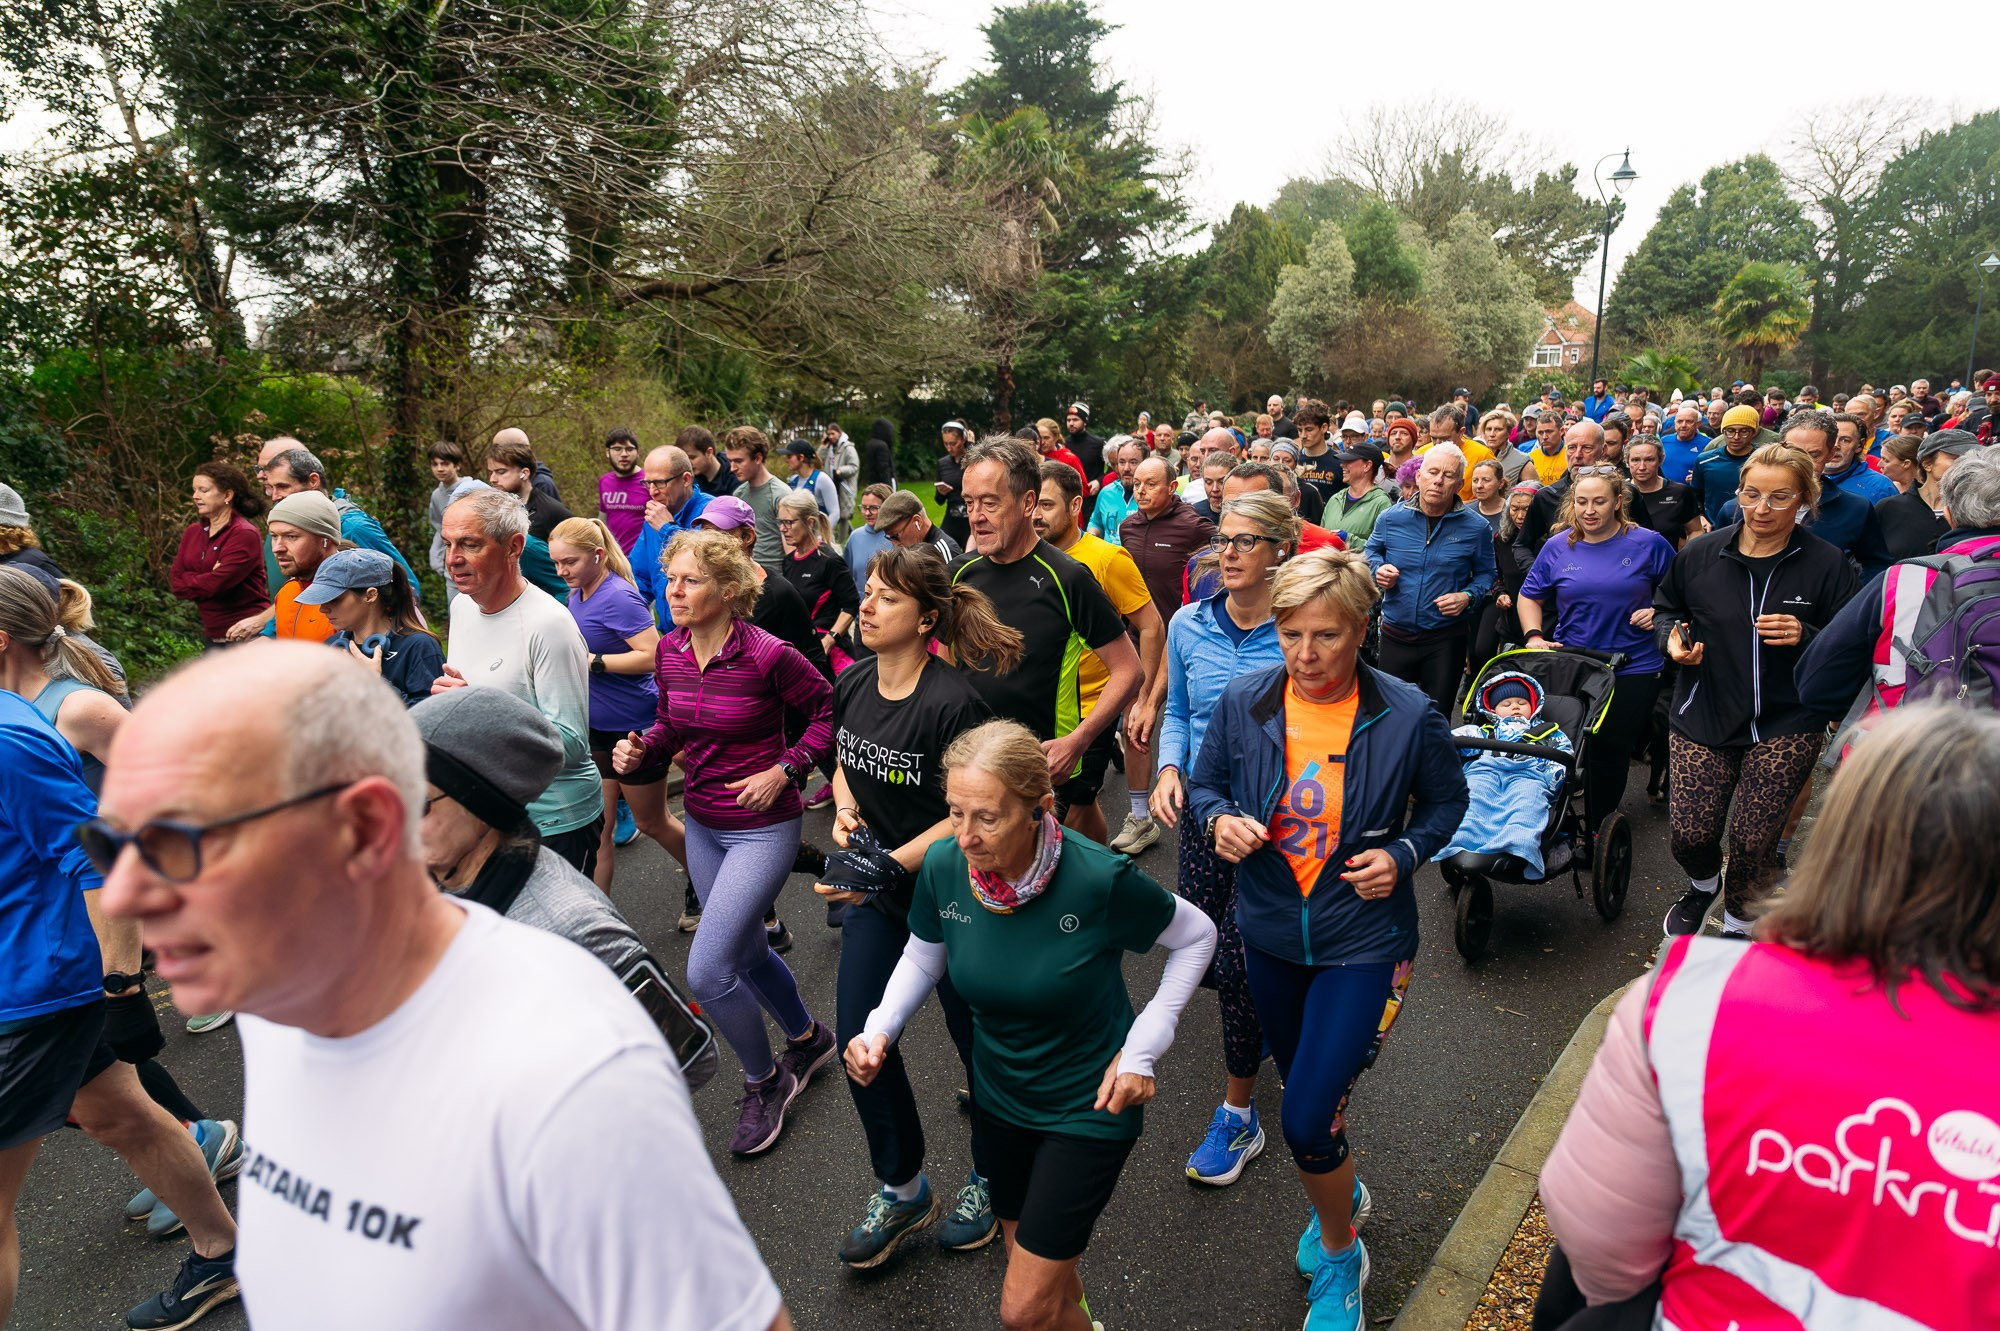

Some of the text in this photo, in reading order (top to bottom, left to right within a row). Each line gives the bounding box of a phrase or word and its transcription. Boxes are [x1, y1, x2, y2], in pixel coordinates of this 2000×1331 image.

[602, 491, 628, 504] run
[859, 740, 925, 769] FOREST
[1279, 816, 1328, 860] 21
[1745, 1096, 2000, 1250] parkru
[346, 1200, 421, 1250] 10K
